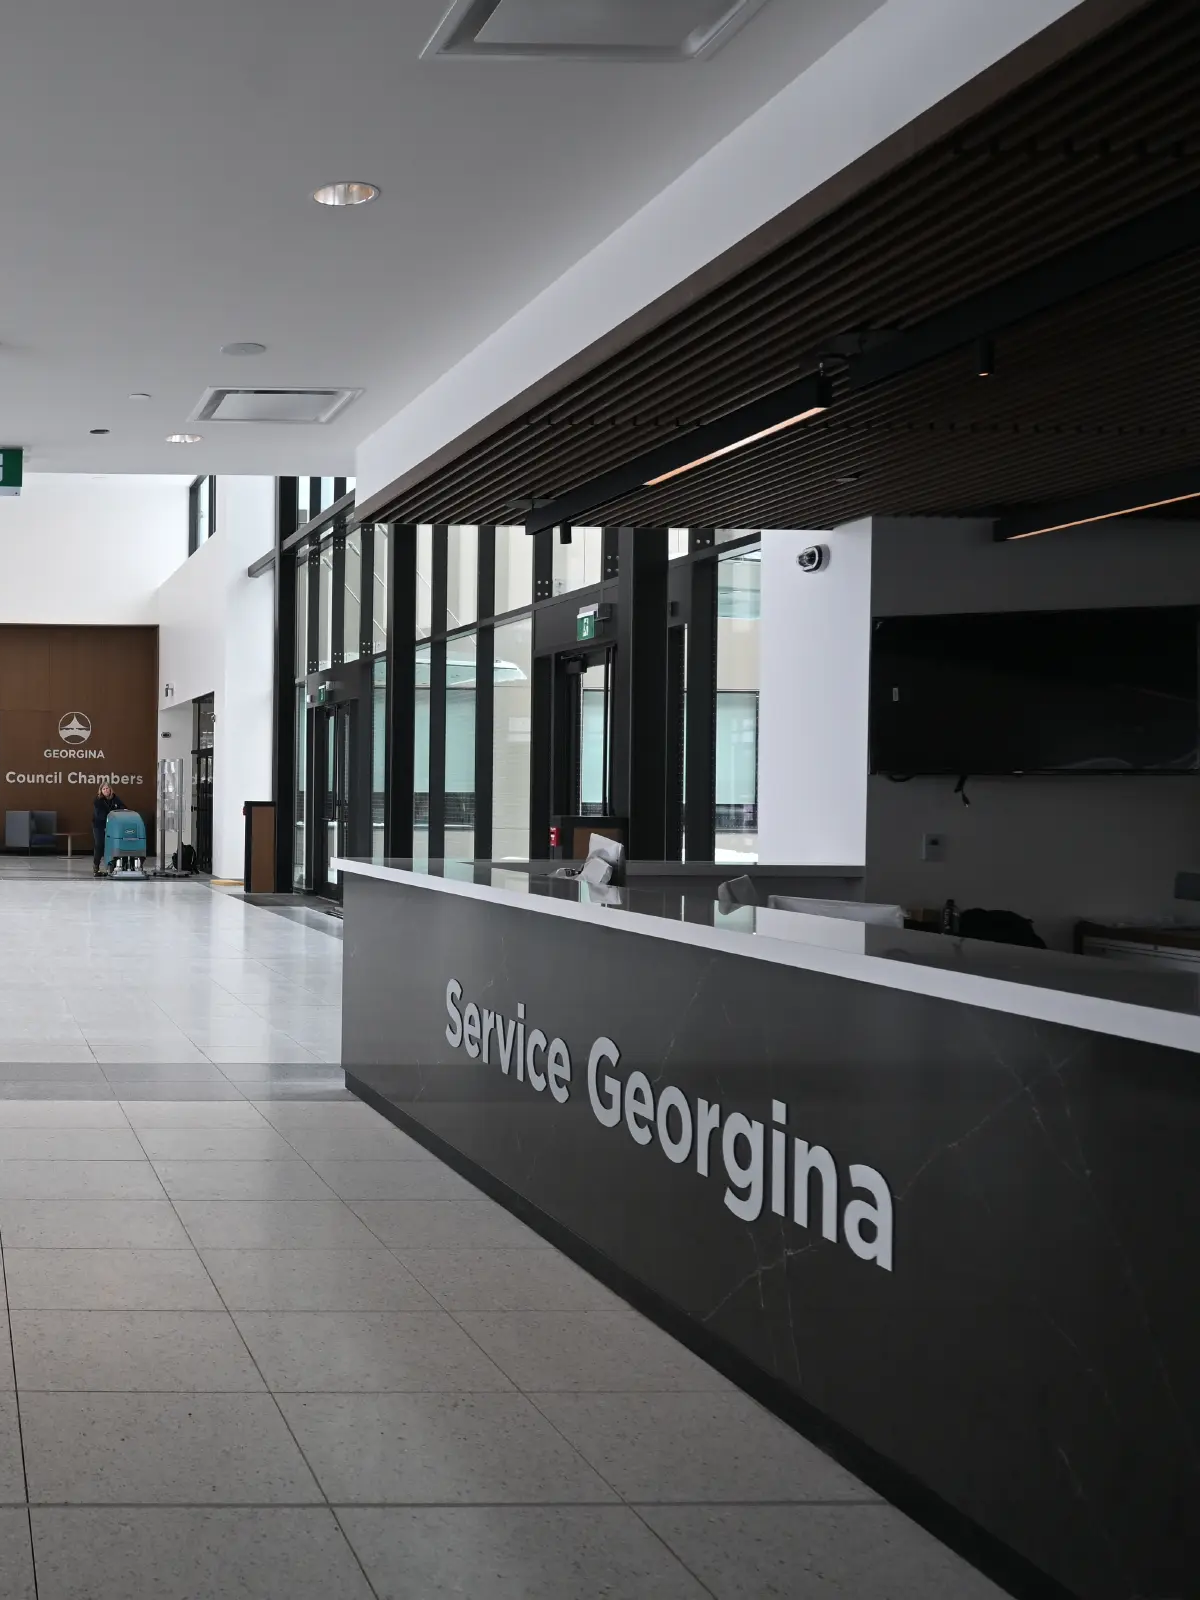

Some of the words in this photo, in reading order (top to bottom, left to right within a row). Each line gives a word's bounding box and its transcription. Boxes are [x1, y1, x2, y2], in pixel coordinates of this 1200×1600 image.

[44, 749, 105, 759] GEORGINA
[5, 771, 62, 784] Council
[67, 771, 144, 785] Chambers
[445, 978, 572, 1104] Service
[587, 1036, 895, 1272] Georgina
